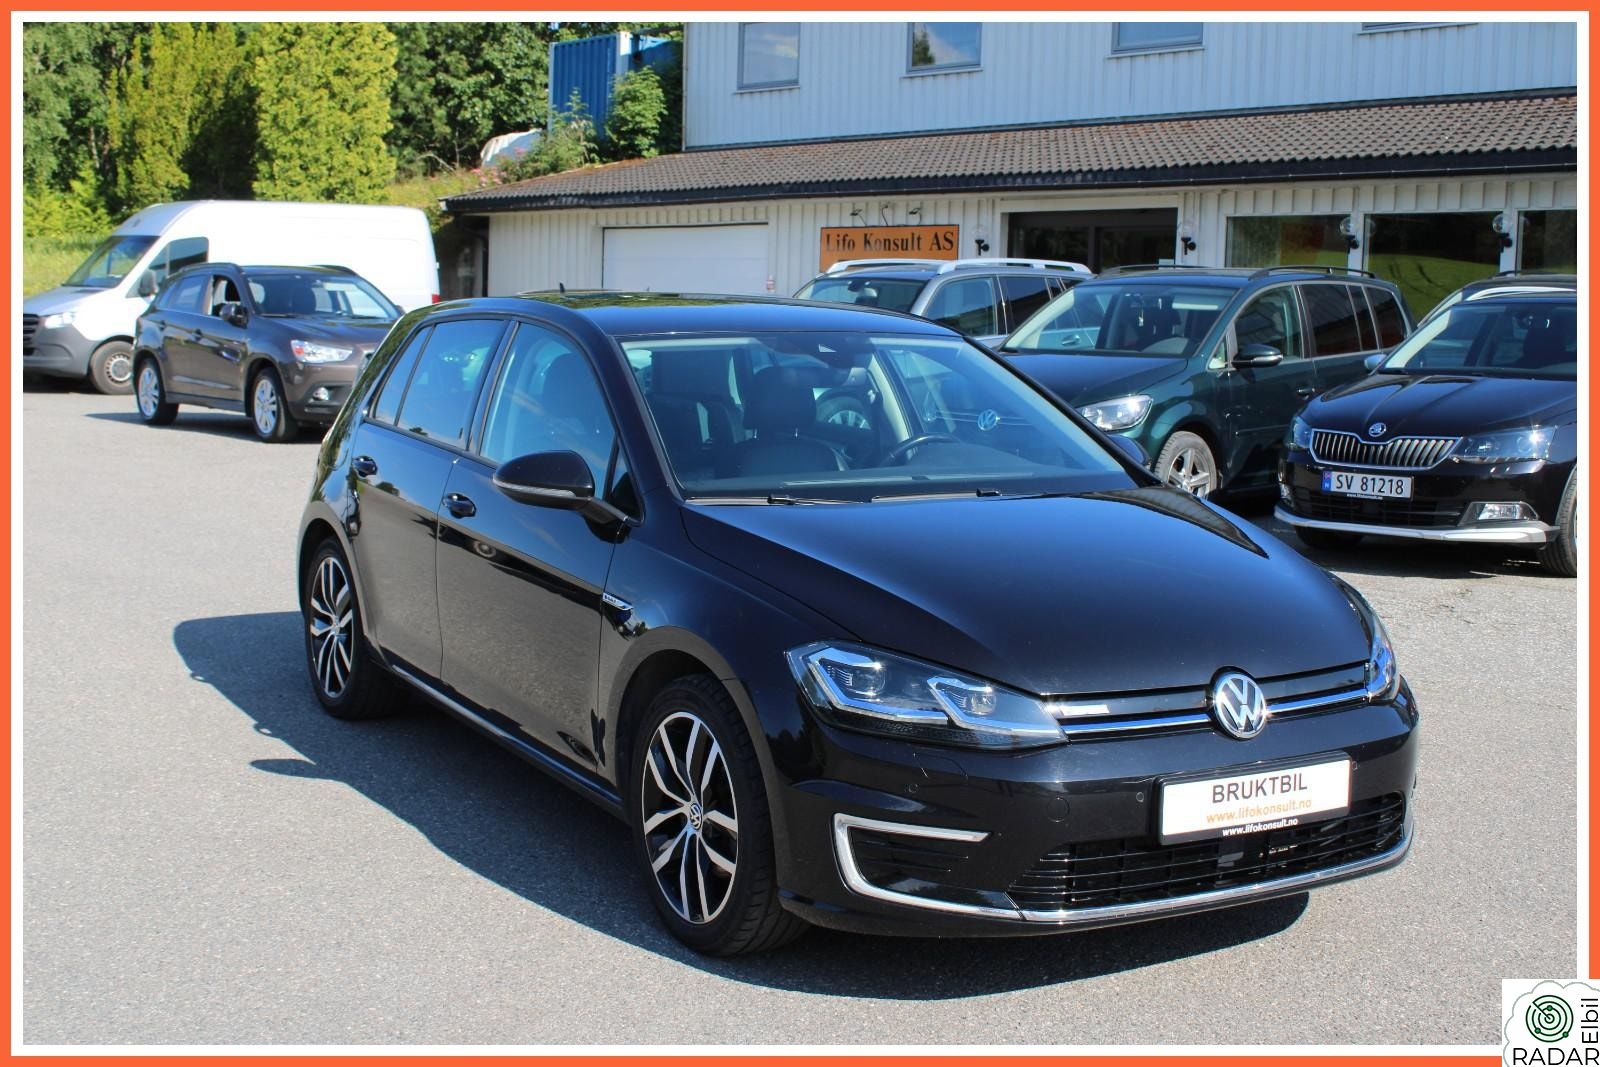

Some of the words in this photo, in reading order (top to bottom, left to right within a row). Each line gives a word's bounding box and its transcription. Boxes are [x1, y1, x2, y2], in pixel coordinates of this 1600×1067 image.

[826, 232, 856, 253] Lifo
[863, 232, 922, 251] Konsult
[929, 231, 954, 251] AS
[1336, 474, 1354, 490] SV
[1360, 476, 1404, 495] 81218
[1212, 773, 1308, 803] BRUKTBIL
[1206, 799, 1312, 824] www.lifokonsult.no
[1222, 818, 1299, 836] www.lifokonsult.no
